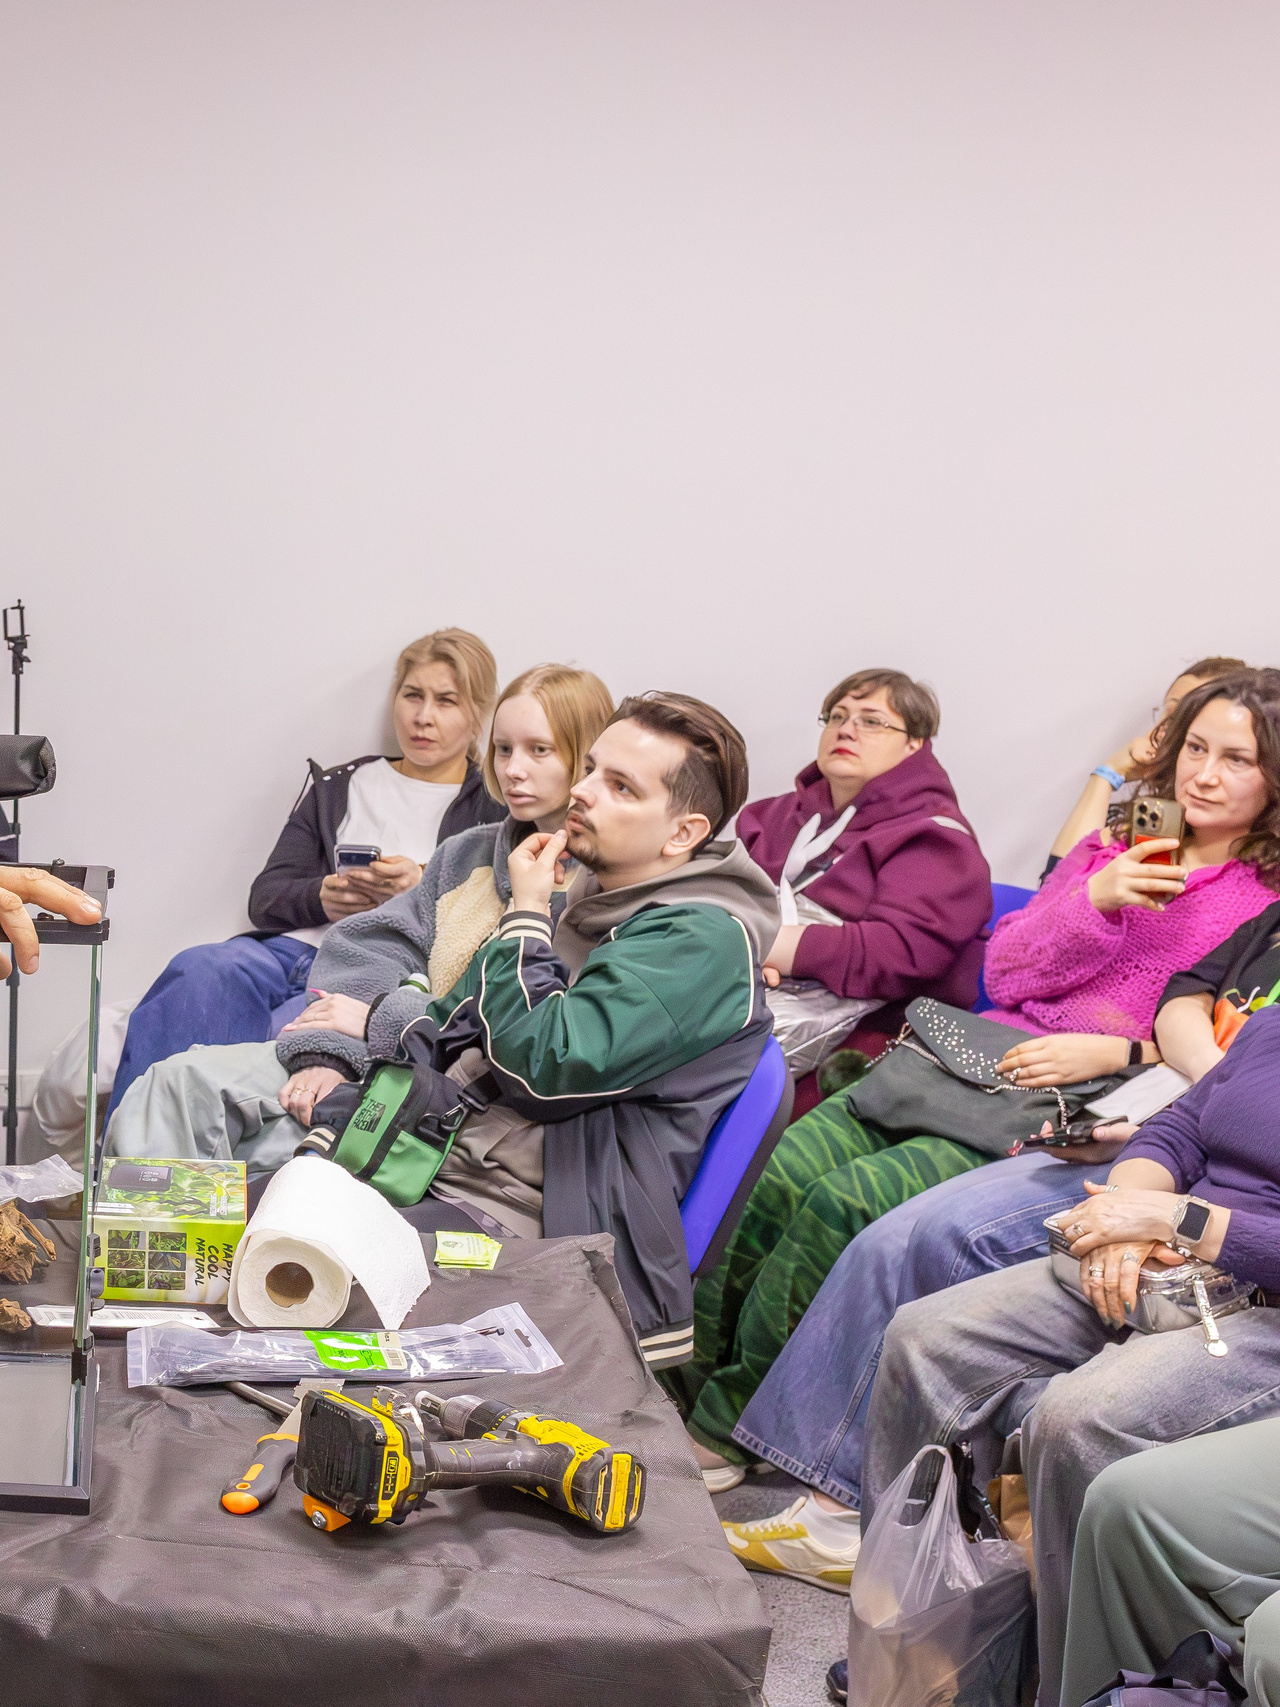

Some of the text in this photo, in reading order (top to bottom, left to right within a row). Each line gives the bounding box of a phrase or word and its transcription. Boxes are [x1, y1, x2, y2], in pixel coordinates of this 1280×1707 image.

[194, 1237, 206, 1286] NATURAL
[207, 1245, 219, 1279] COOL
[221, 1242, 234, 1283] HAPPY
